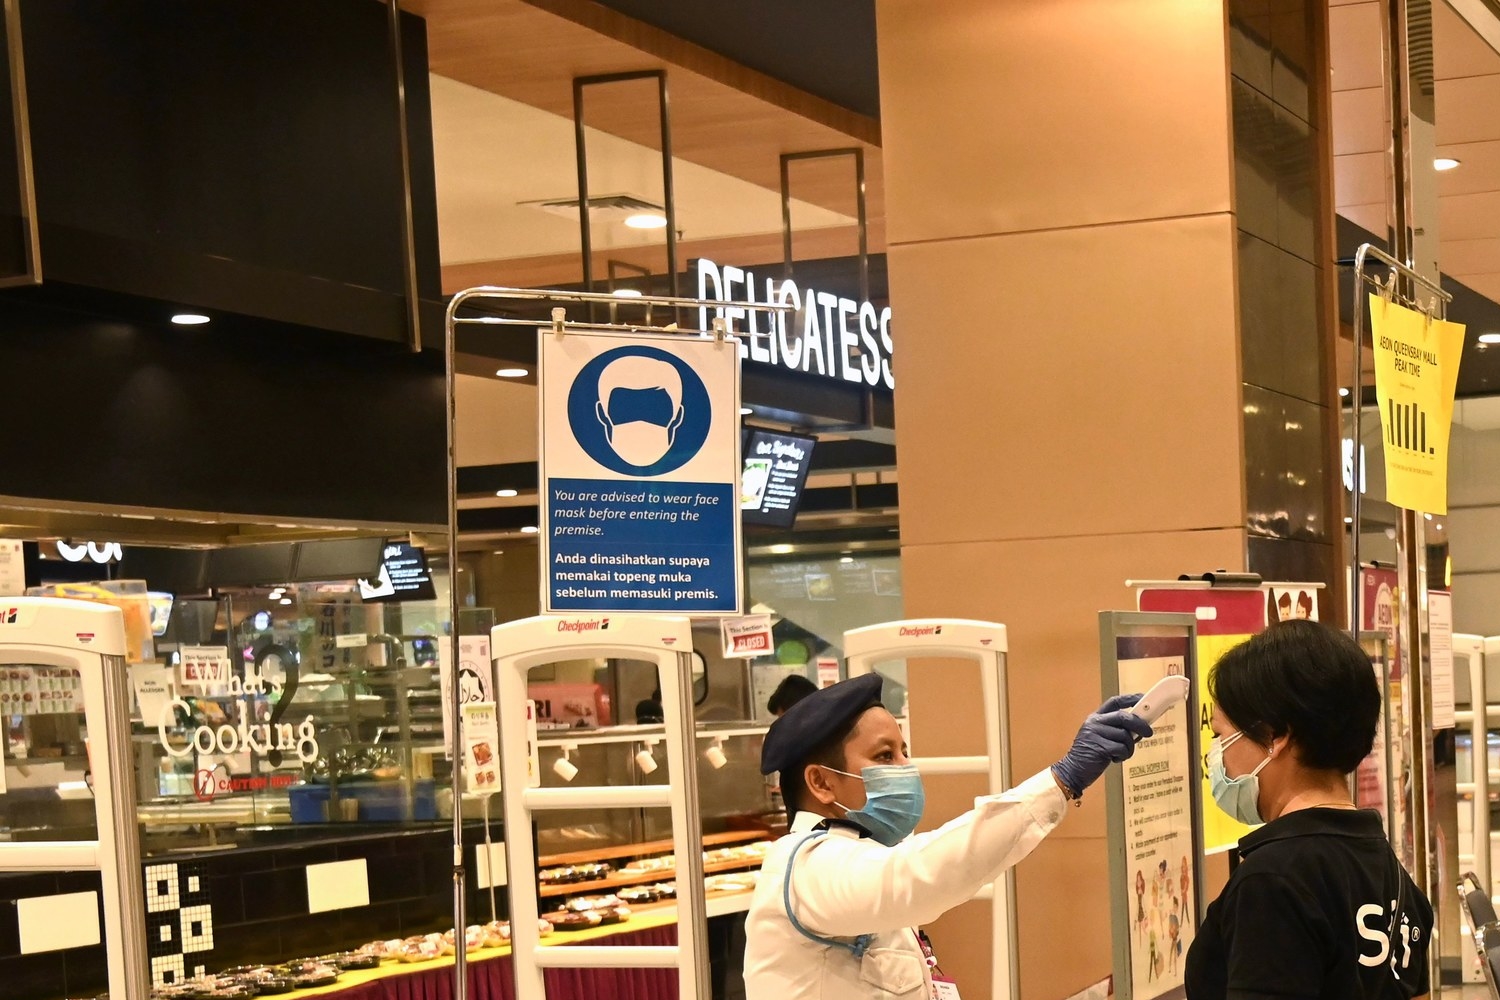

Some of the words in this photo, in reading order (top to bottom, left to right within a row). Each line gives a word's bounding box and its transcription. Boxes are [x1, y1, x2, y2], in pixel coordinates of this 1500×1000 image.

[1379, 335, 1393, 352] AEON
[1394, 341, 1423, 361] QUEENSBAY
[1422, 352, 1438, 366] MALL
[1394, 358, 1408, 374] PEAK
[1408, 362, 1421, 378] TIME
[555, 490, 575, 502] You
[578, 491, 598, 503] are
[601, 492, 645, 504] advised
[649, 493, 660, 504] to
[663, 494, 693, 505] wear
[693, 493, 720, 507] face
[554, 507, 586, 519] mask
[588, 507, 627, 521] before
[629, 509, 678, 523] entering
[681, 511, 700, 522] the
[554, 524, 605, 537] premise.
[555, 553, 587, 565] Anda
[589, 553, 666, 566] dinasihatkan
[669, 556, 710, 568] supaya
[555, 571, 611, 582] memakai
[614, 572, 656, 585] topeng
[659, 571, 692, 583] muka
[555, 587, 607, 599] sebelum
[610, 588, 672, 600] memasuki
[674, 589, 719, 601] premis.
[558, 619, 600, 634] Checkpoint
[742, 624, 763, 633] Section
[899, 626, 934, 638] Checkpoint
[738, 635, 765, 650] CLOSED
[158, 694, 319, 764] Cooking
